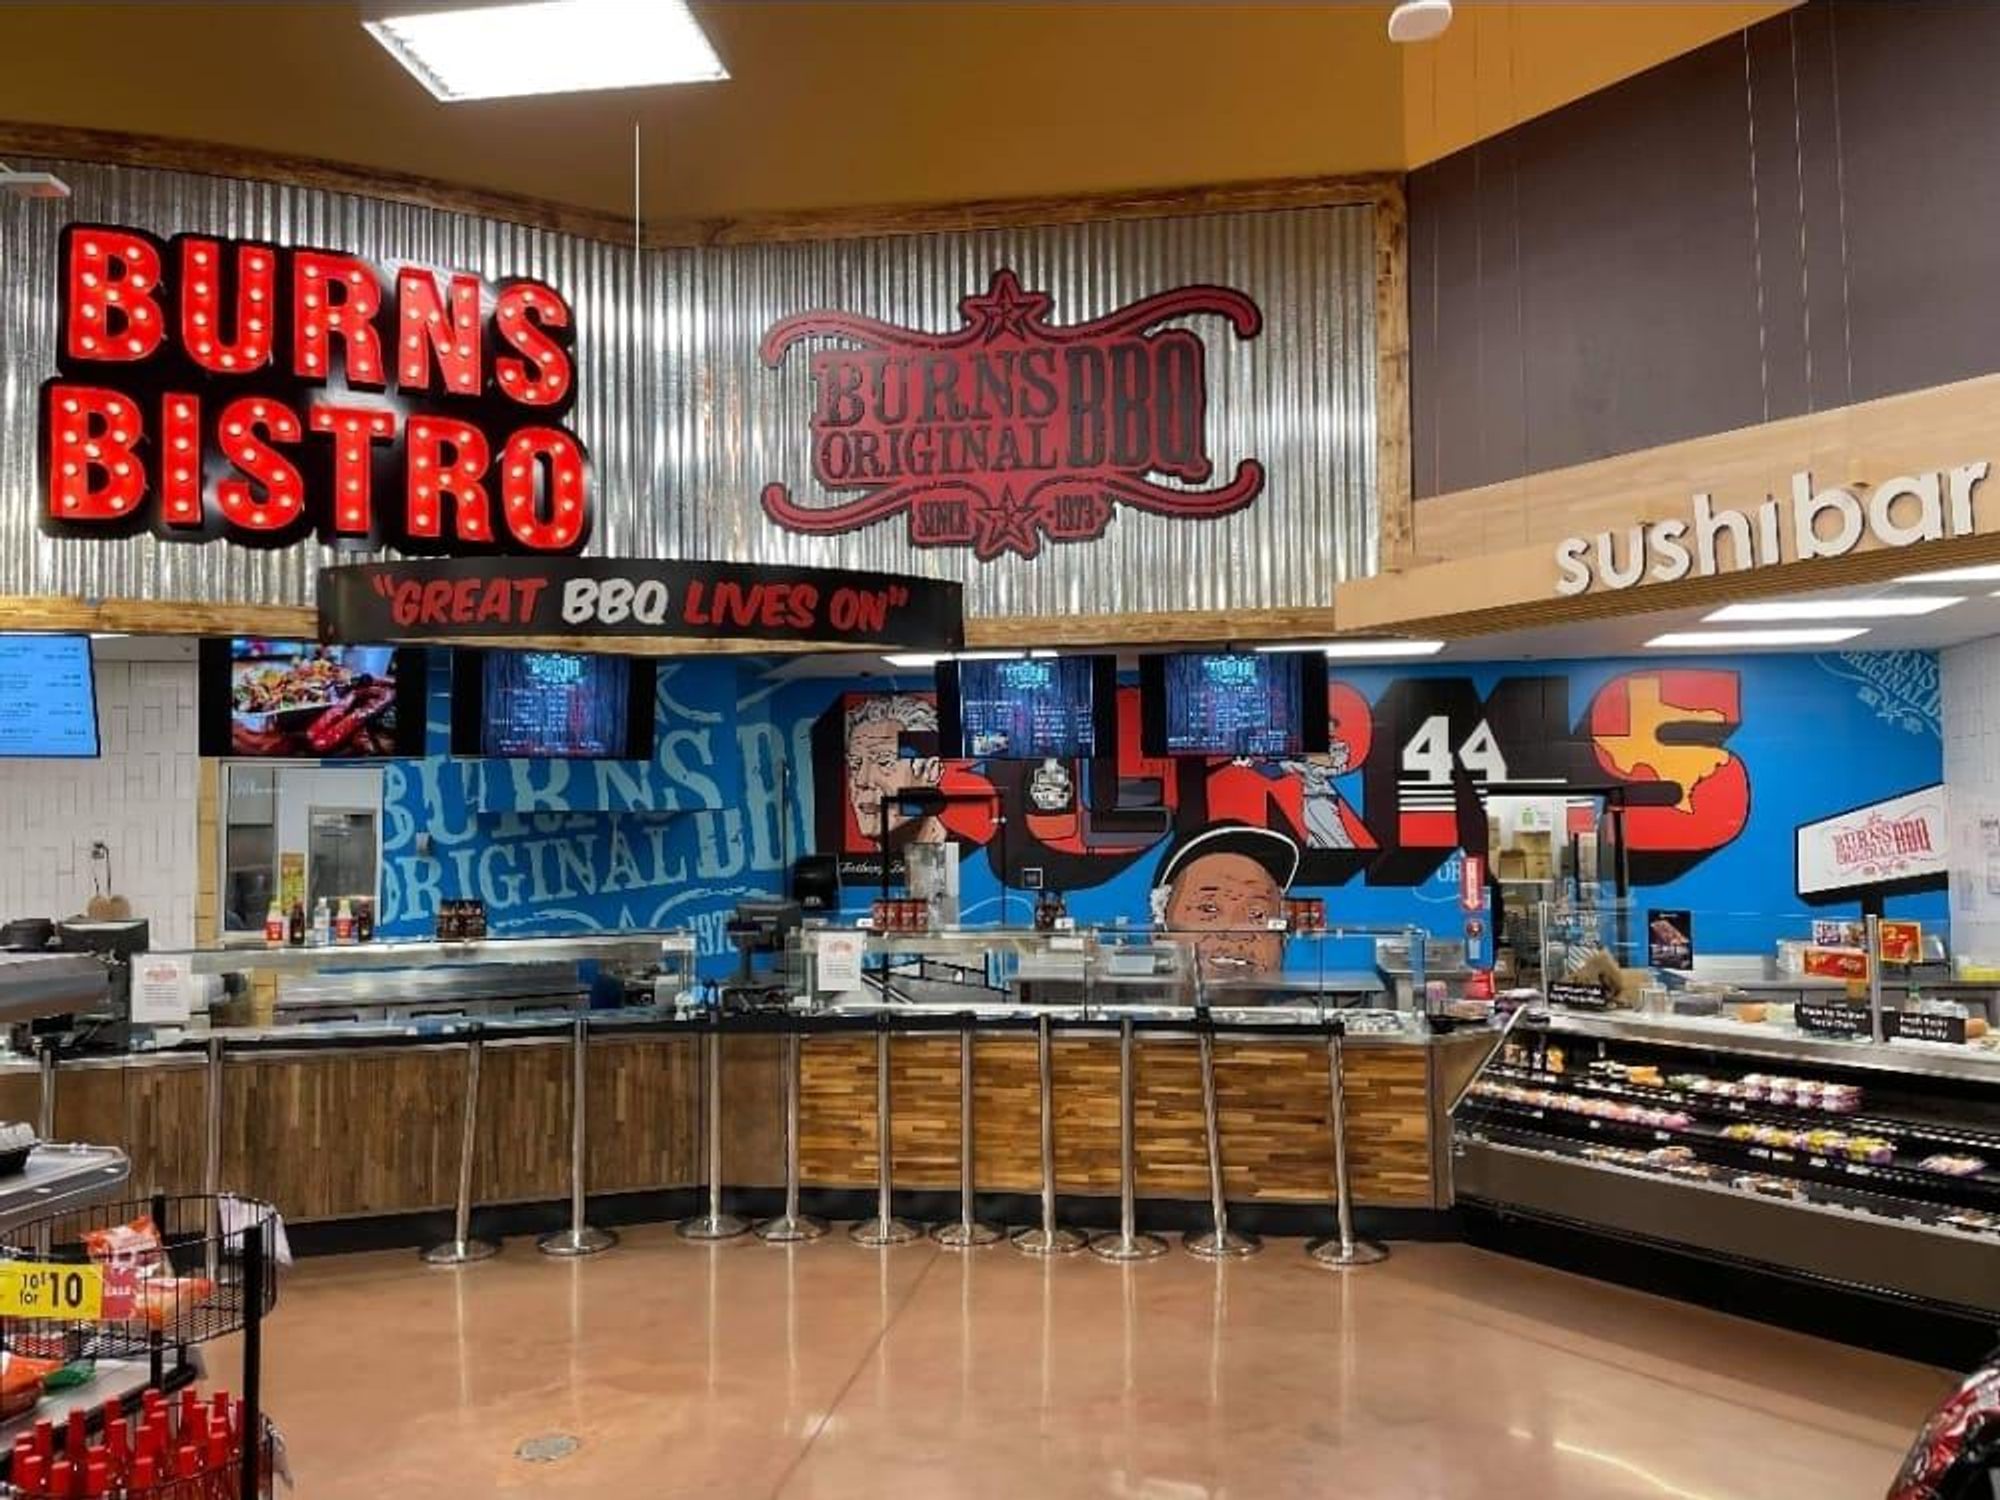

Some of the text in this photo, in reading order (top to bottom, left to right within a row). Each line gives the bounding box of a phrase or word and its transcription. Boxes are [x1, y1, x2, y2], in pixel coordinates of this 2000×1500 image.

[66, 228, 572, 406] BURNS
[48, 384, 586, 551] BISTRO
[820, 339, 1201, 473] BURNS BBQ
[820, 426, 1058, 478] ORIGINAL
[1555, 461, 1990, 597] sushi bar
[562, 577, 669, 626] BBQ
[683, 580, 819, 629] LIVES
[1402, 716, 1507, 784] 44
